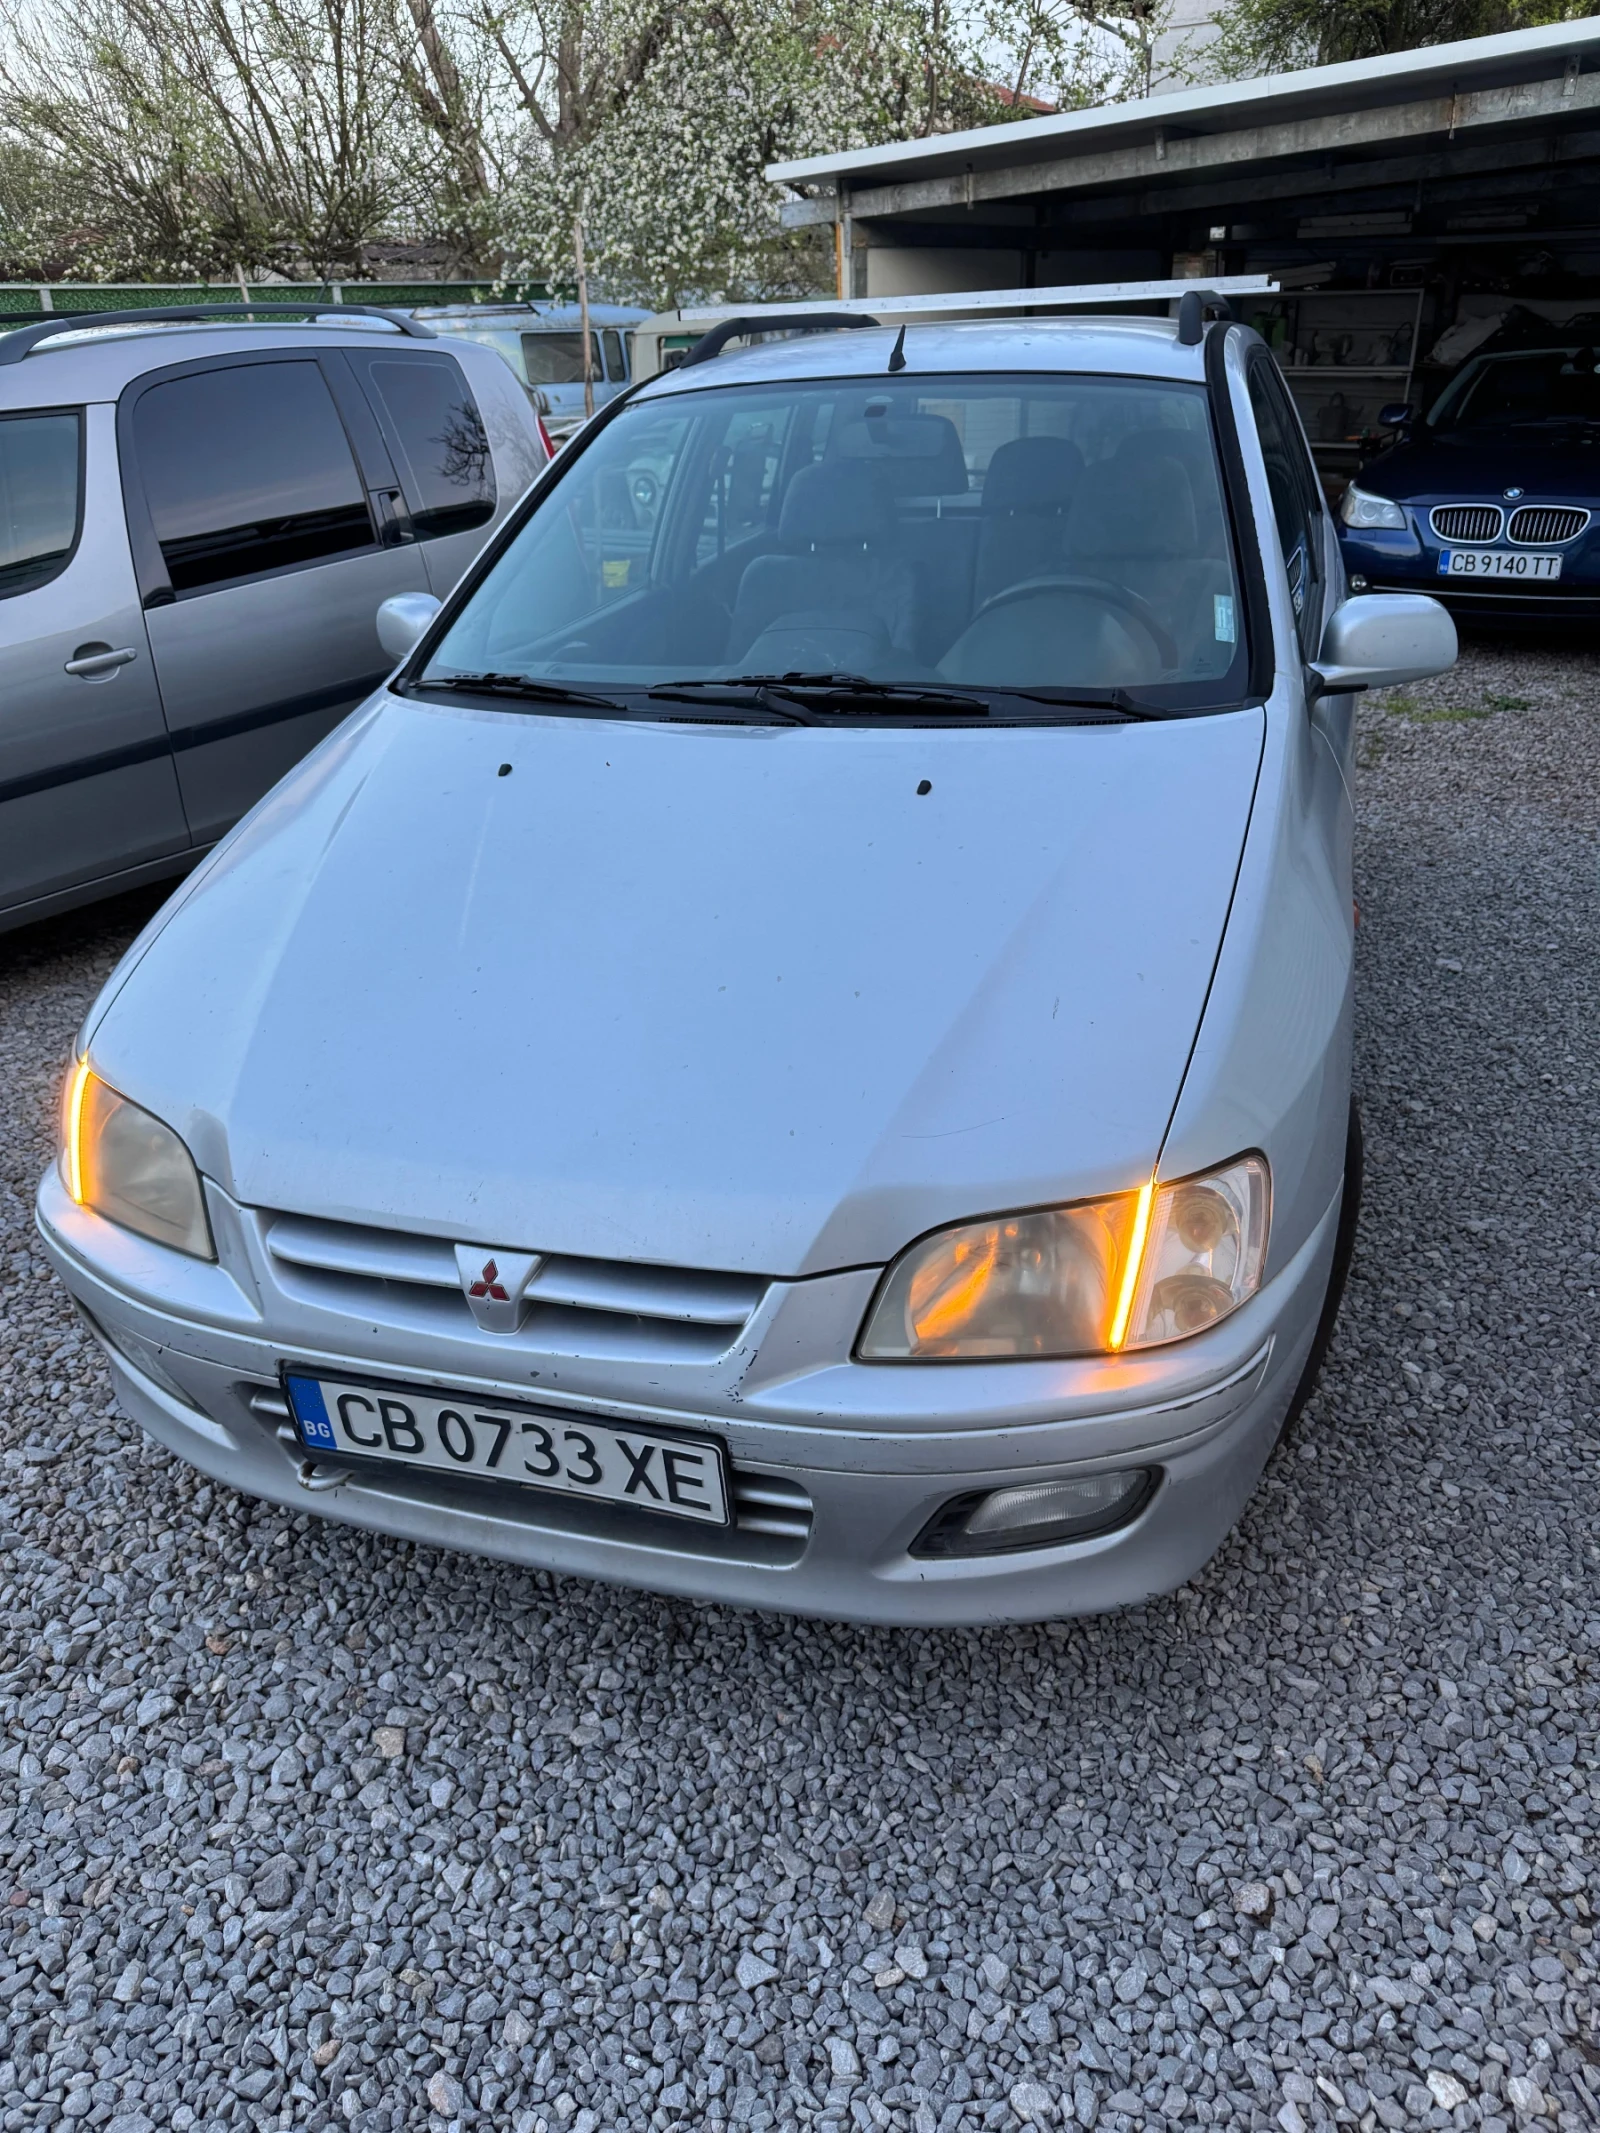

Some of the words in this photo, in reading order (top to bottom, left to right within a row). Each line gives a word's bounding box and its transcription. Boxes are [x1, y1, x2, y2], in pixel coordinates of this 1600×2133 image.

[1452, 554, 1476, 572] CB
[1481, 555, 1527, 575] 9140
[1533, 556, 1558, 575] TT
[303, 1420, 331, 1438] BG
[337, 1393, 425, 1454] CB
[437, 1409, 603, 1485] 0733
[615, 1438, 711, 1511] XE
